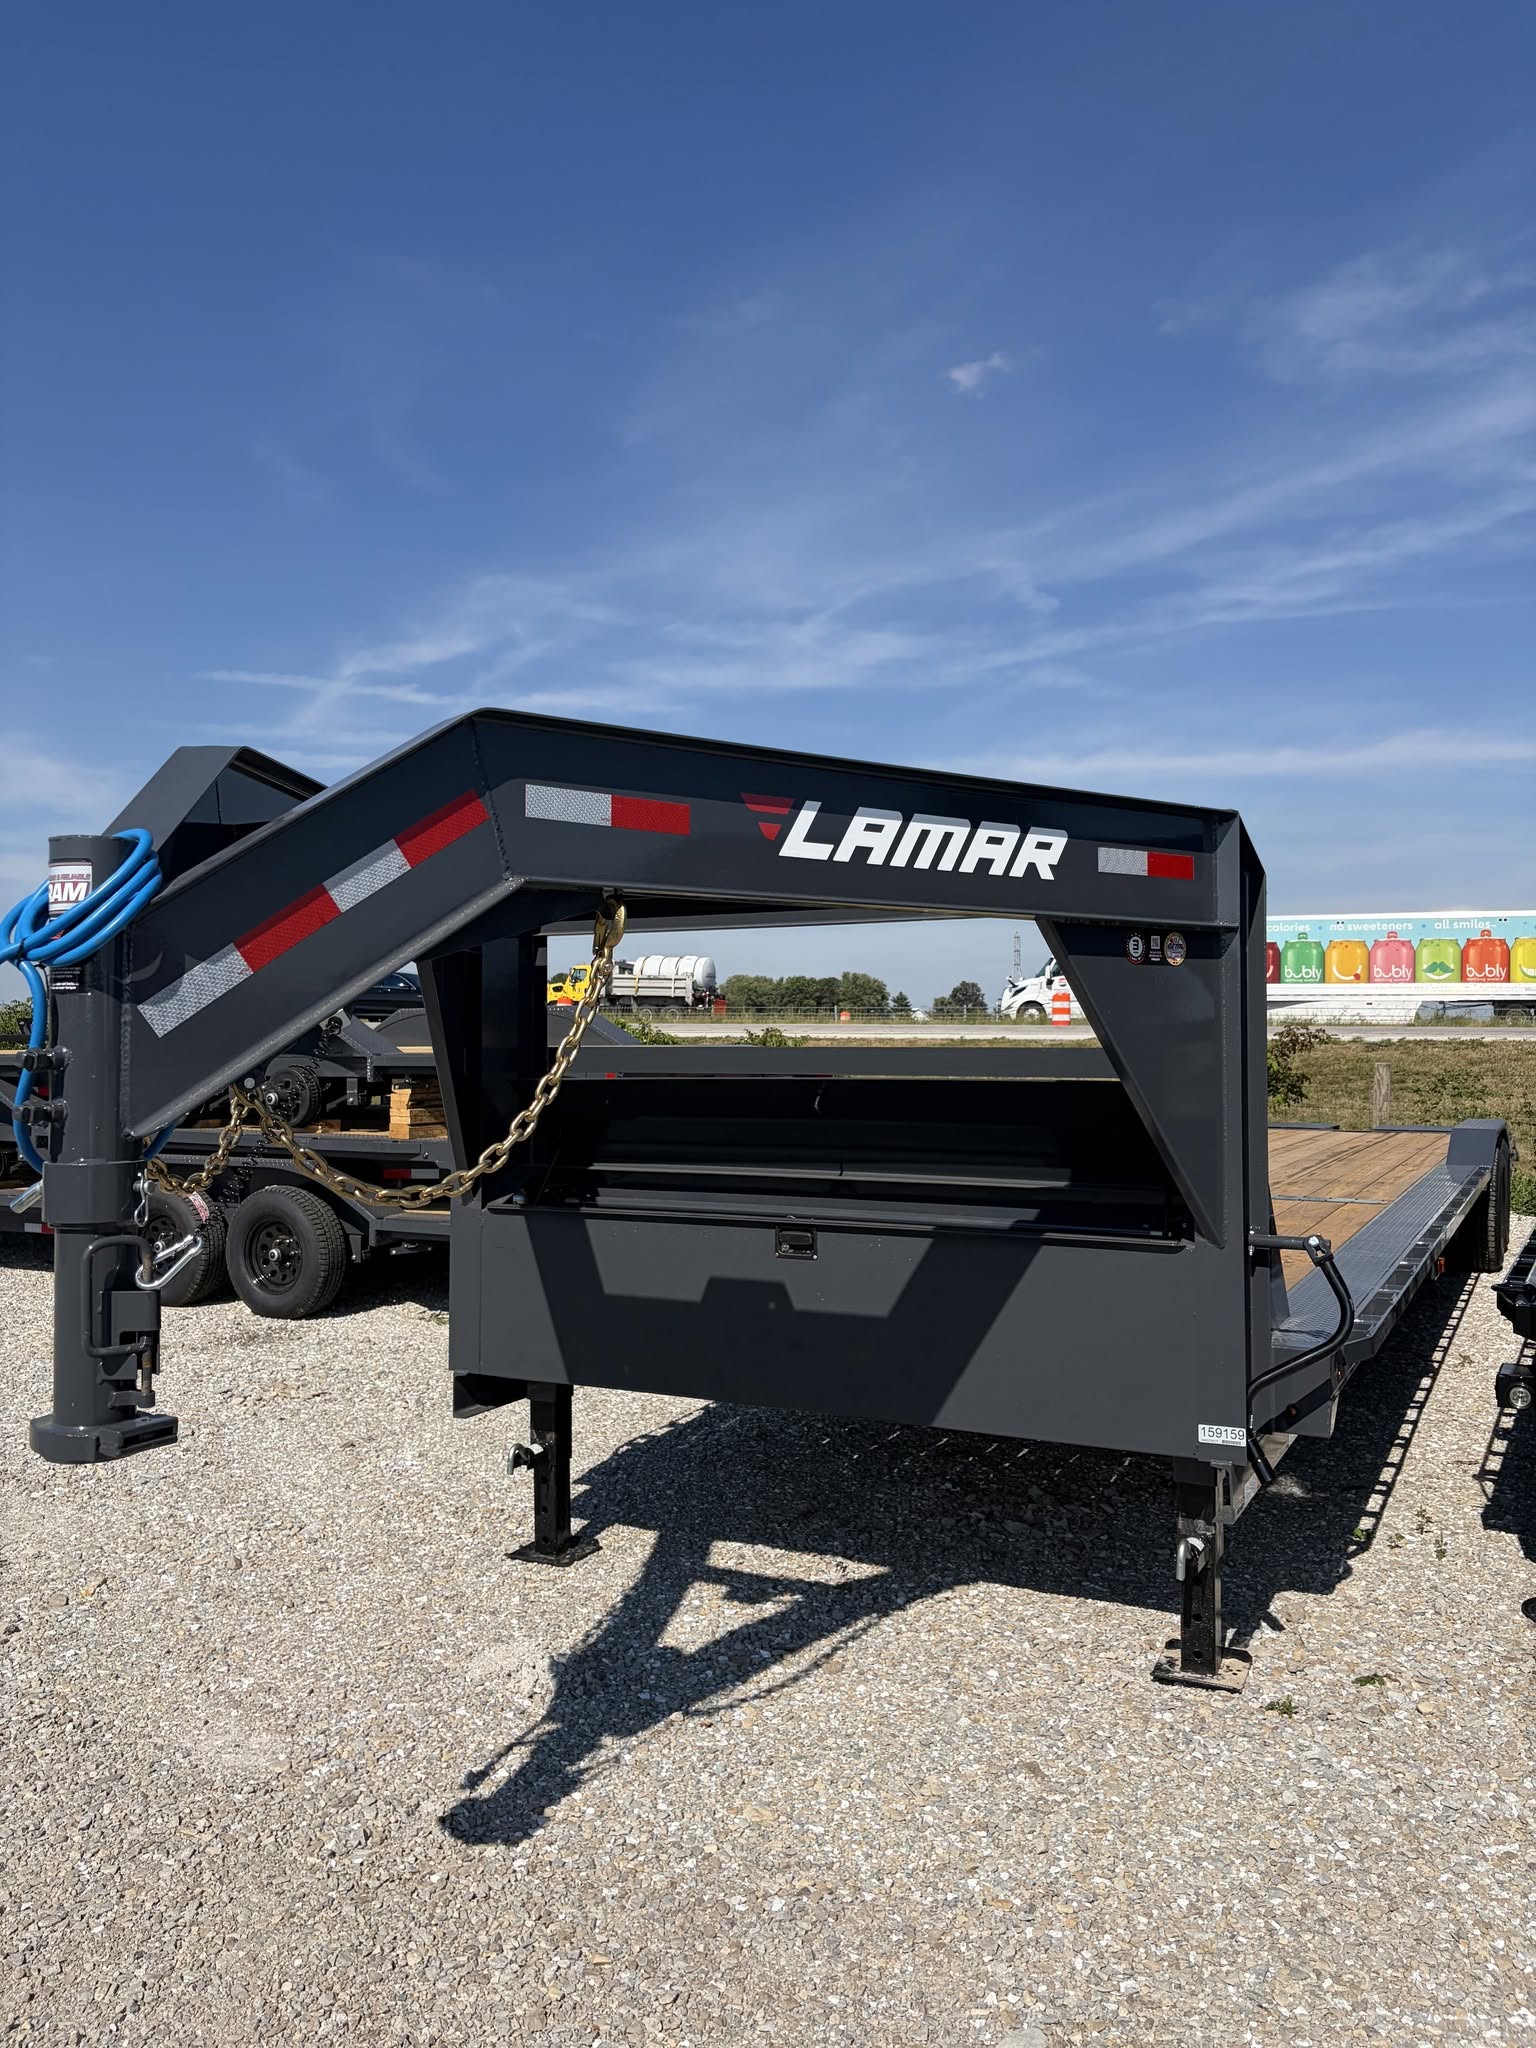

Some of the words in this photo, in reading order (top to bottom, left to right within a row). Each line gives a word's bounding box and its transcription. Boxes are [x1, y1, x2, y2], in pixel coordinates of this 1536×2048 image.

[778, 800, 1068, 880] LAMAR
[1267, 923, 1311, 932] calories
[1347, 922, 1414, 931] sweeteners
[1434, 919, 1450, 930] all
[1284, 965, 1322, 980] bubly
[1373, 965, 1412, 980] bubly
[1466, 963, 1507, 980] bubly
[1200, 1427, 1245, 1440] 159159
